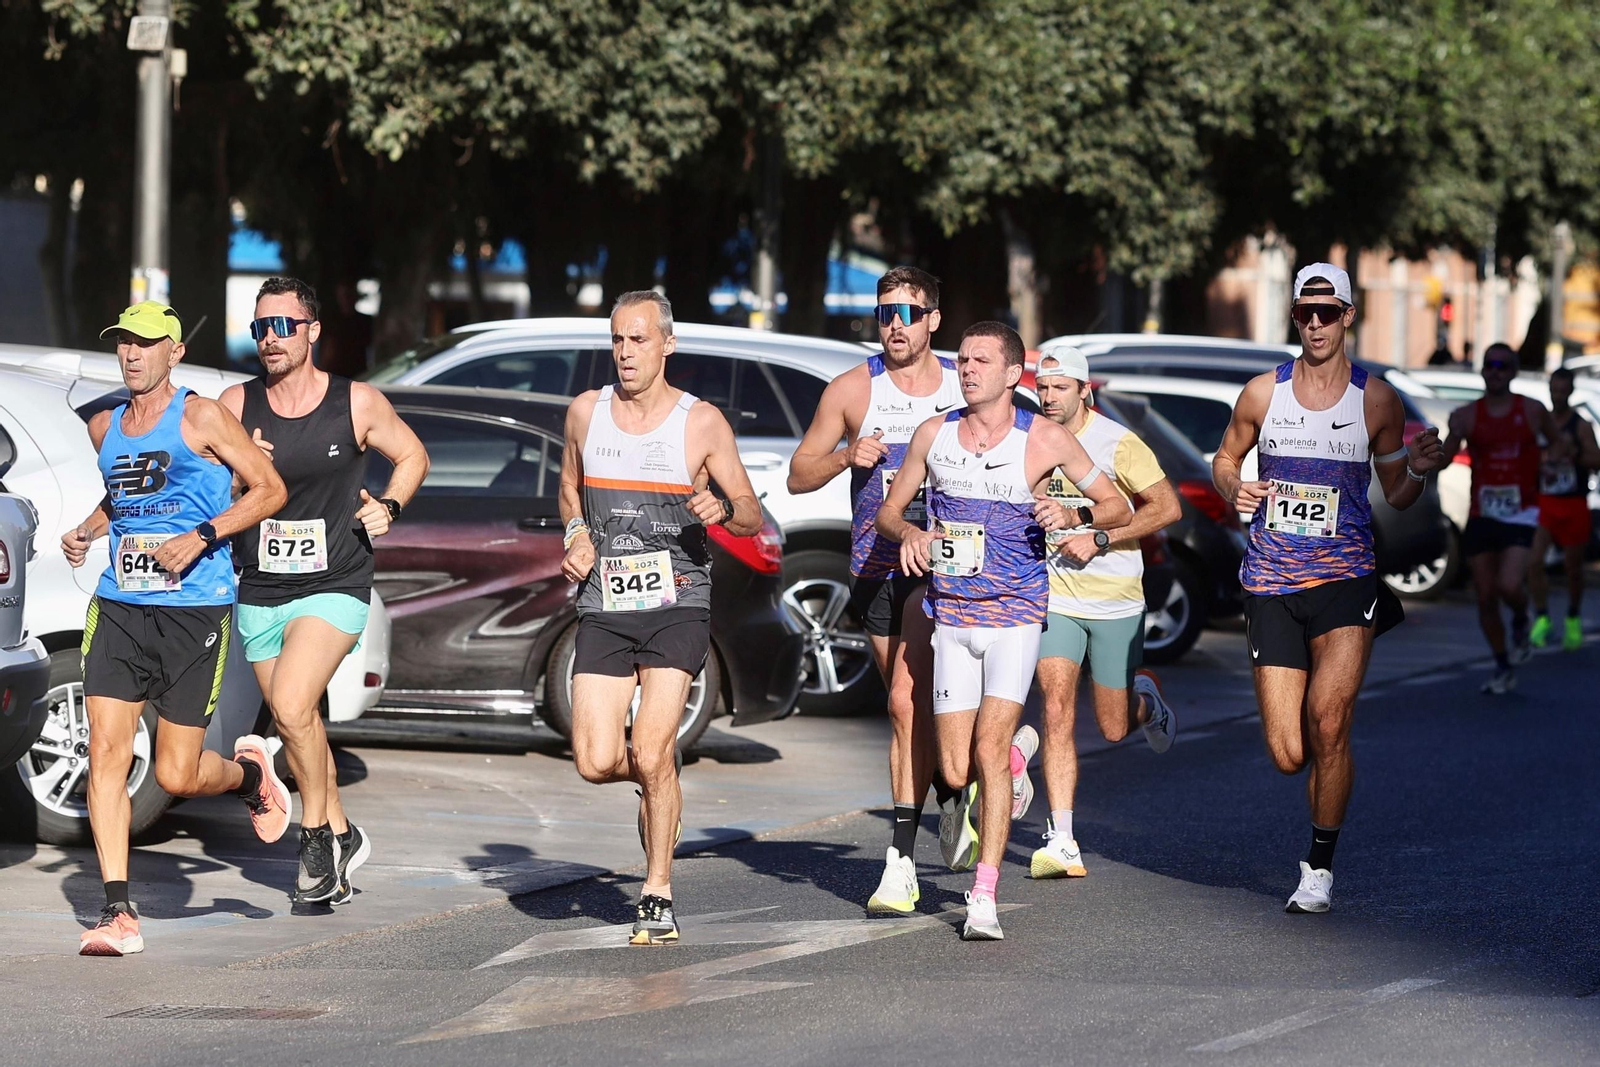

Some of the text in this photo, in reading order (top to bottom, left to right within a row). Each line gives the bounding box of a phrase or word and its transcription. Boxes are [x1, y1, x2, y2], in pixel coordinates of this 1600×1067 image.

[887, 424, 917, 433] abelen
[1280, 437, 1317, 447] abelenda
[596, 447, 622, 458] GOBIK
[936, 476, 973, 488] abelenda
[1304, 491, 1328, 499] 2025
[1277, 500, 1326, 522] 142
[291, 527, 315, 535] 2025
[650, 521, 682, 533] Torres
[949, 529, 973, 537] 2025
[142, 541, 163, 549] 202
[267, 538, 316, 557] 672
[941, 539, 955, 559] 5
[634, 560, 659, 569] 2025
[610, 572, 662, 595] 342
